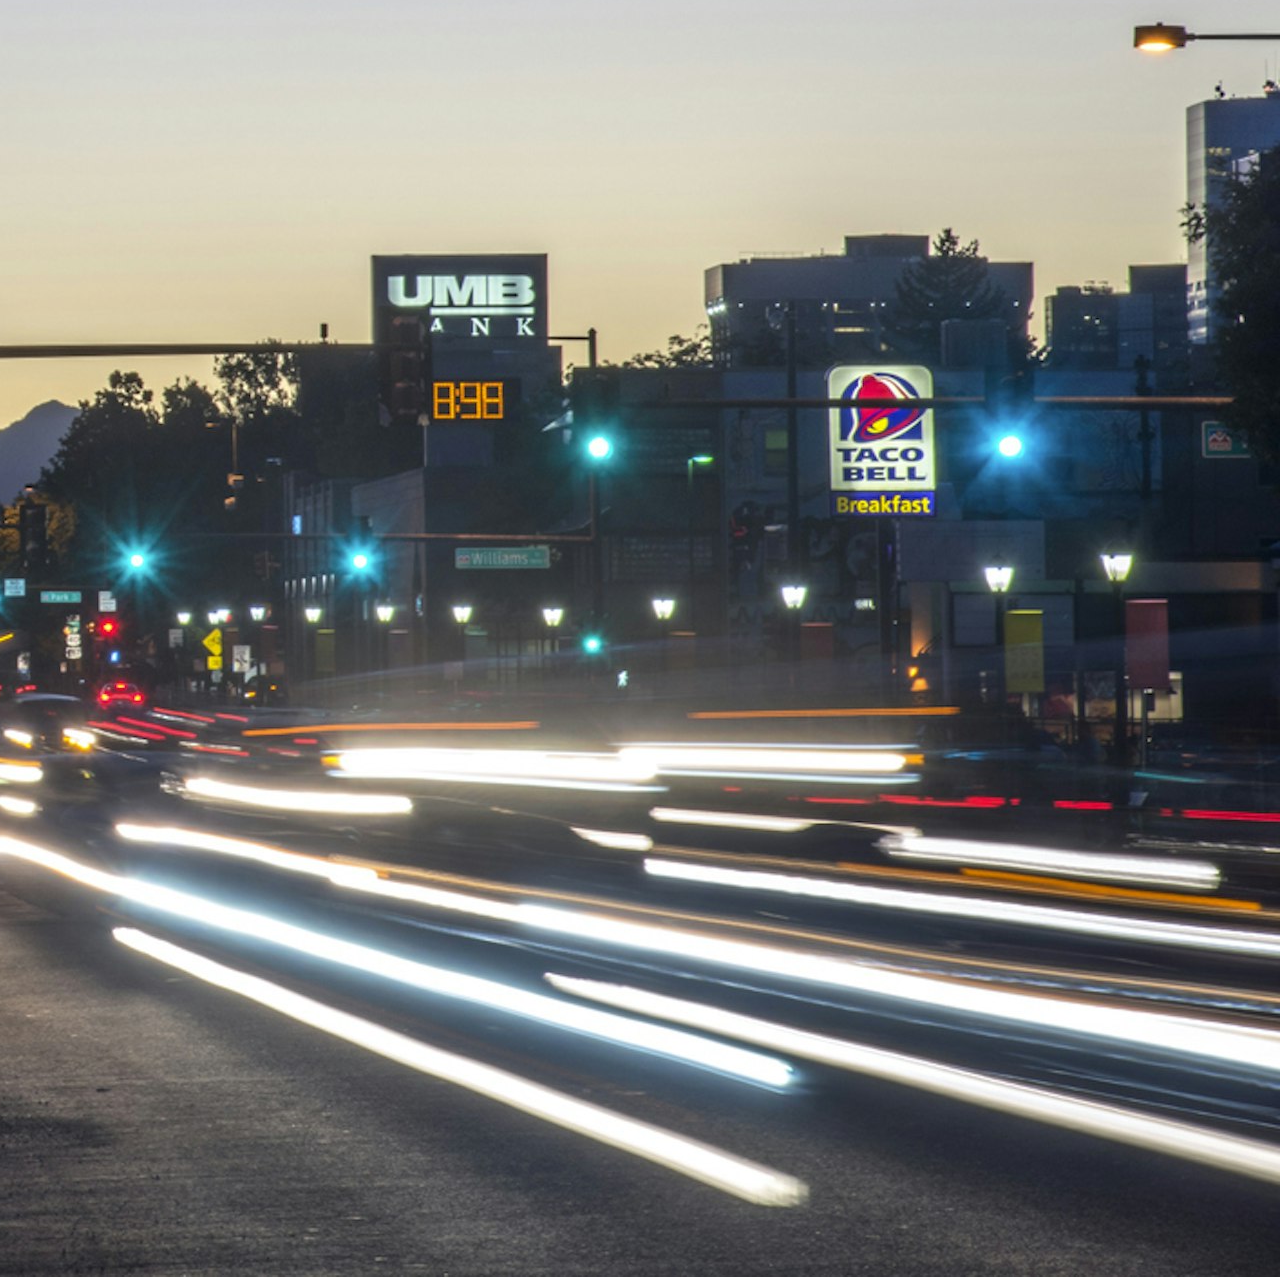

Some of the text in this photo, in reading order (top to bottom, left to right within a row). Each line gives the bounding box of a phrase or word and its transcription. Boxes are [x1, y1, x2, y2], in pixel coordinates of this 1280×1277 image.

[387, 275, 536, 307] UMB
[429, 317, 535, 337] ANK
[836, 447, 925, 463] TACO
[842, 466, 927, 482] BELL
[836, 494, 931, 514] Breakfast
[471, 550, 529, 565] Williams
